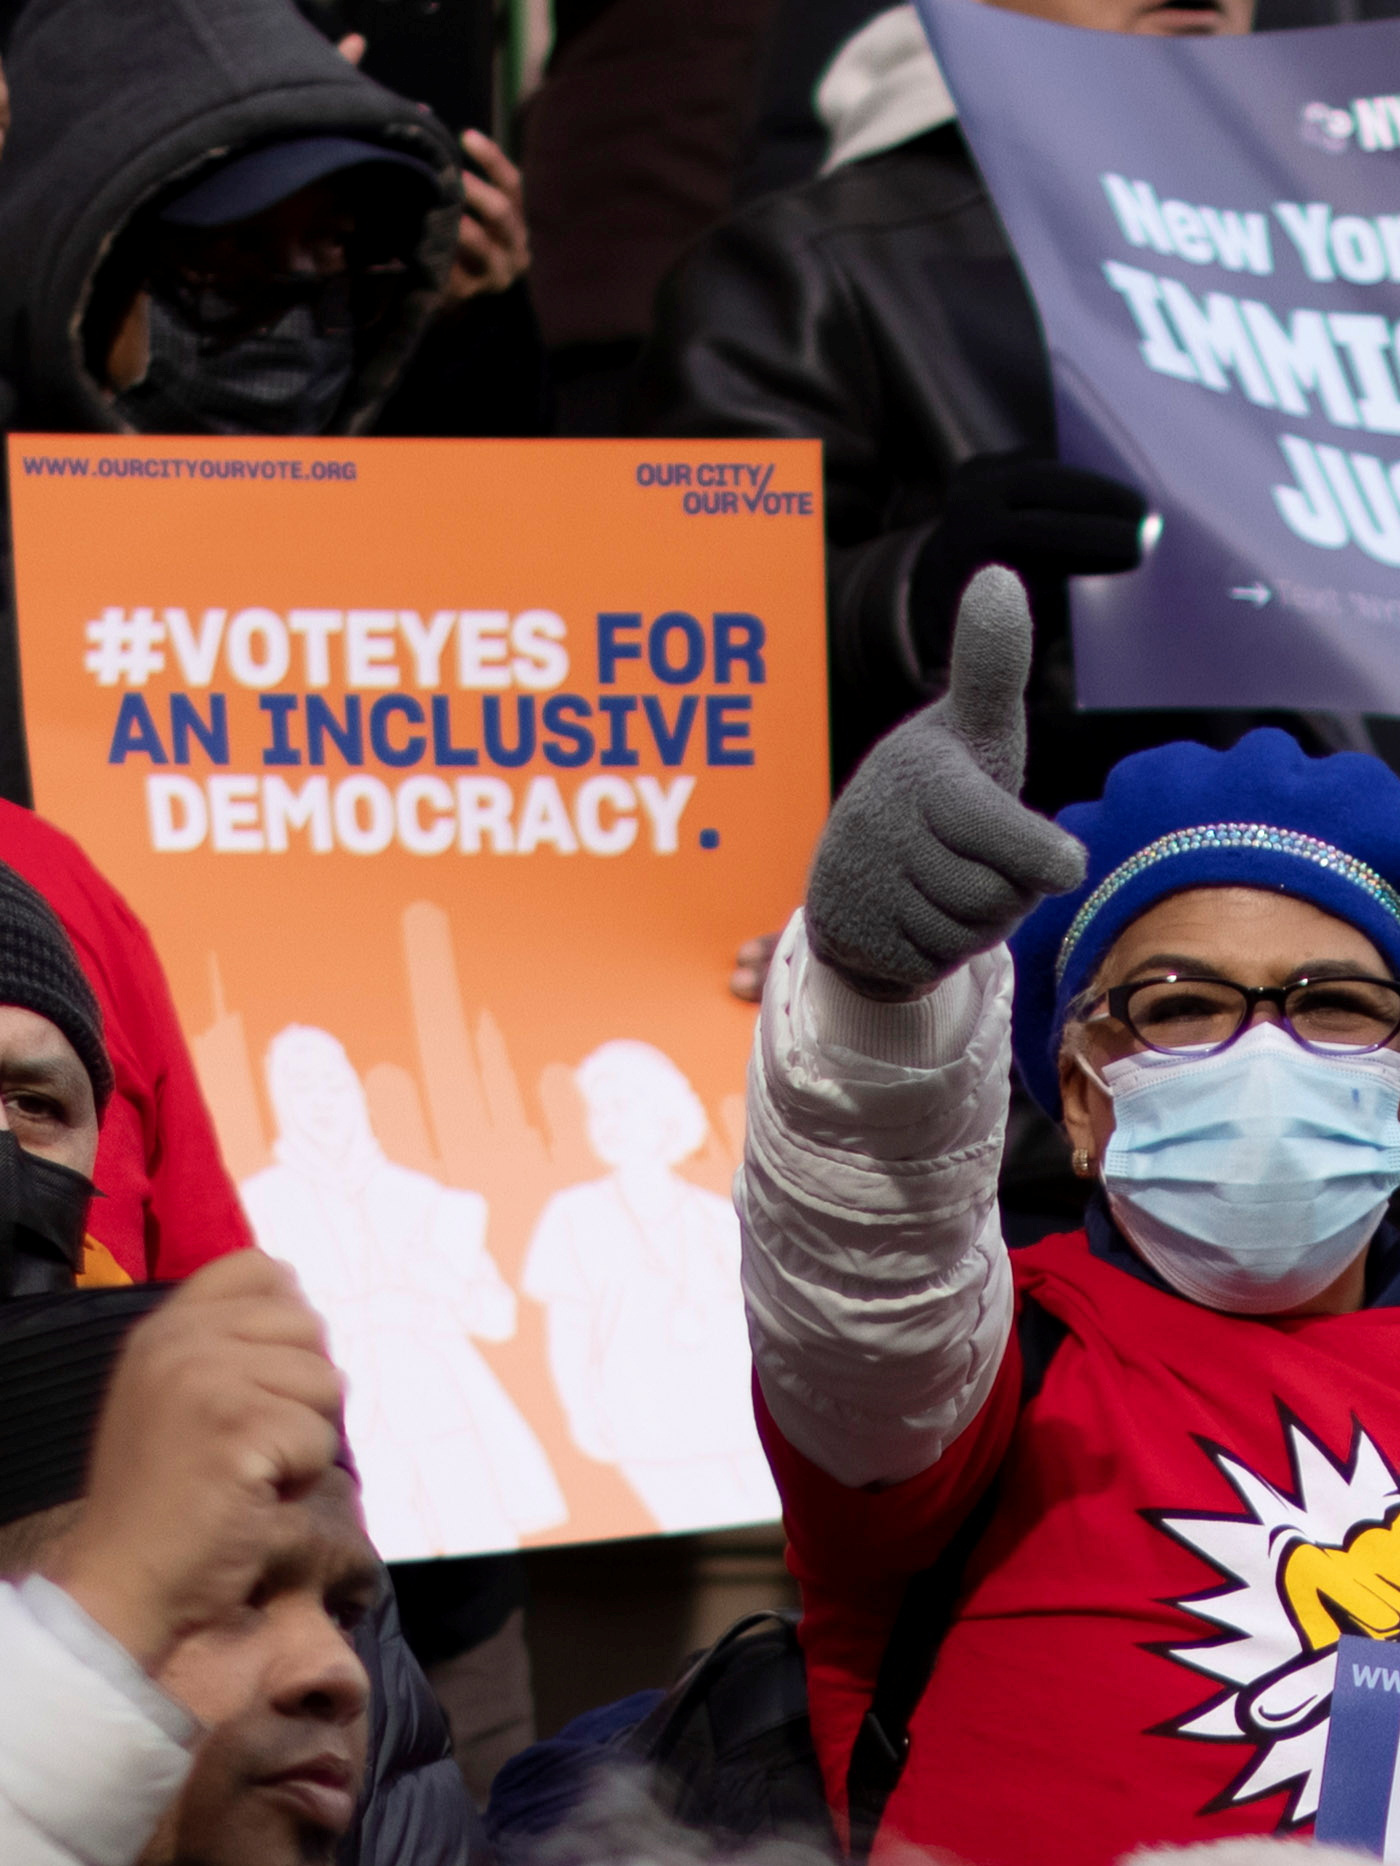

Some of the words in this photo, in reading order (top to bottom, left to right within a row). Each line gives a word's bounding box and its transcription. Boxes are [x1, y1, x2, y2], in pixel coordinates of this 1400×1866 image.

[1101, 172, 1275, 276] New
[23, 456, 357, 481] WWW.OURCITYOURVOTE.ORG
[636, 463, 692, 487] OUR
[683, 491, 738, 515] OUR
[742, 491, 814, 515] VOTE
[84, 607, 568, 688] #VOTEYES
[597, 613, 767, 684] FOR
[108, 693, 230, 764] AN
[258, 694, 755, 767] INCLUSIVE
[145, 774, 720, 855] DEMOCRACY.
